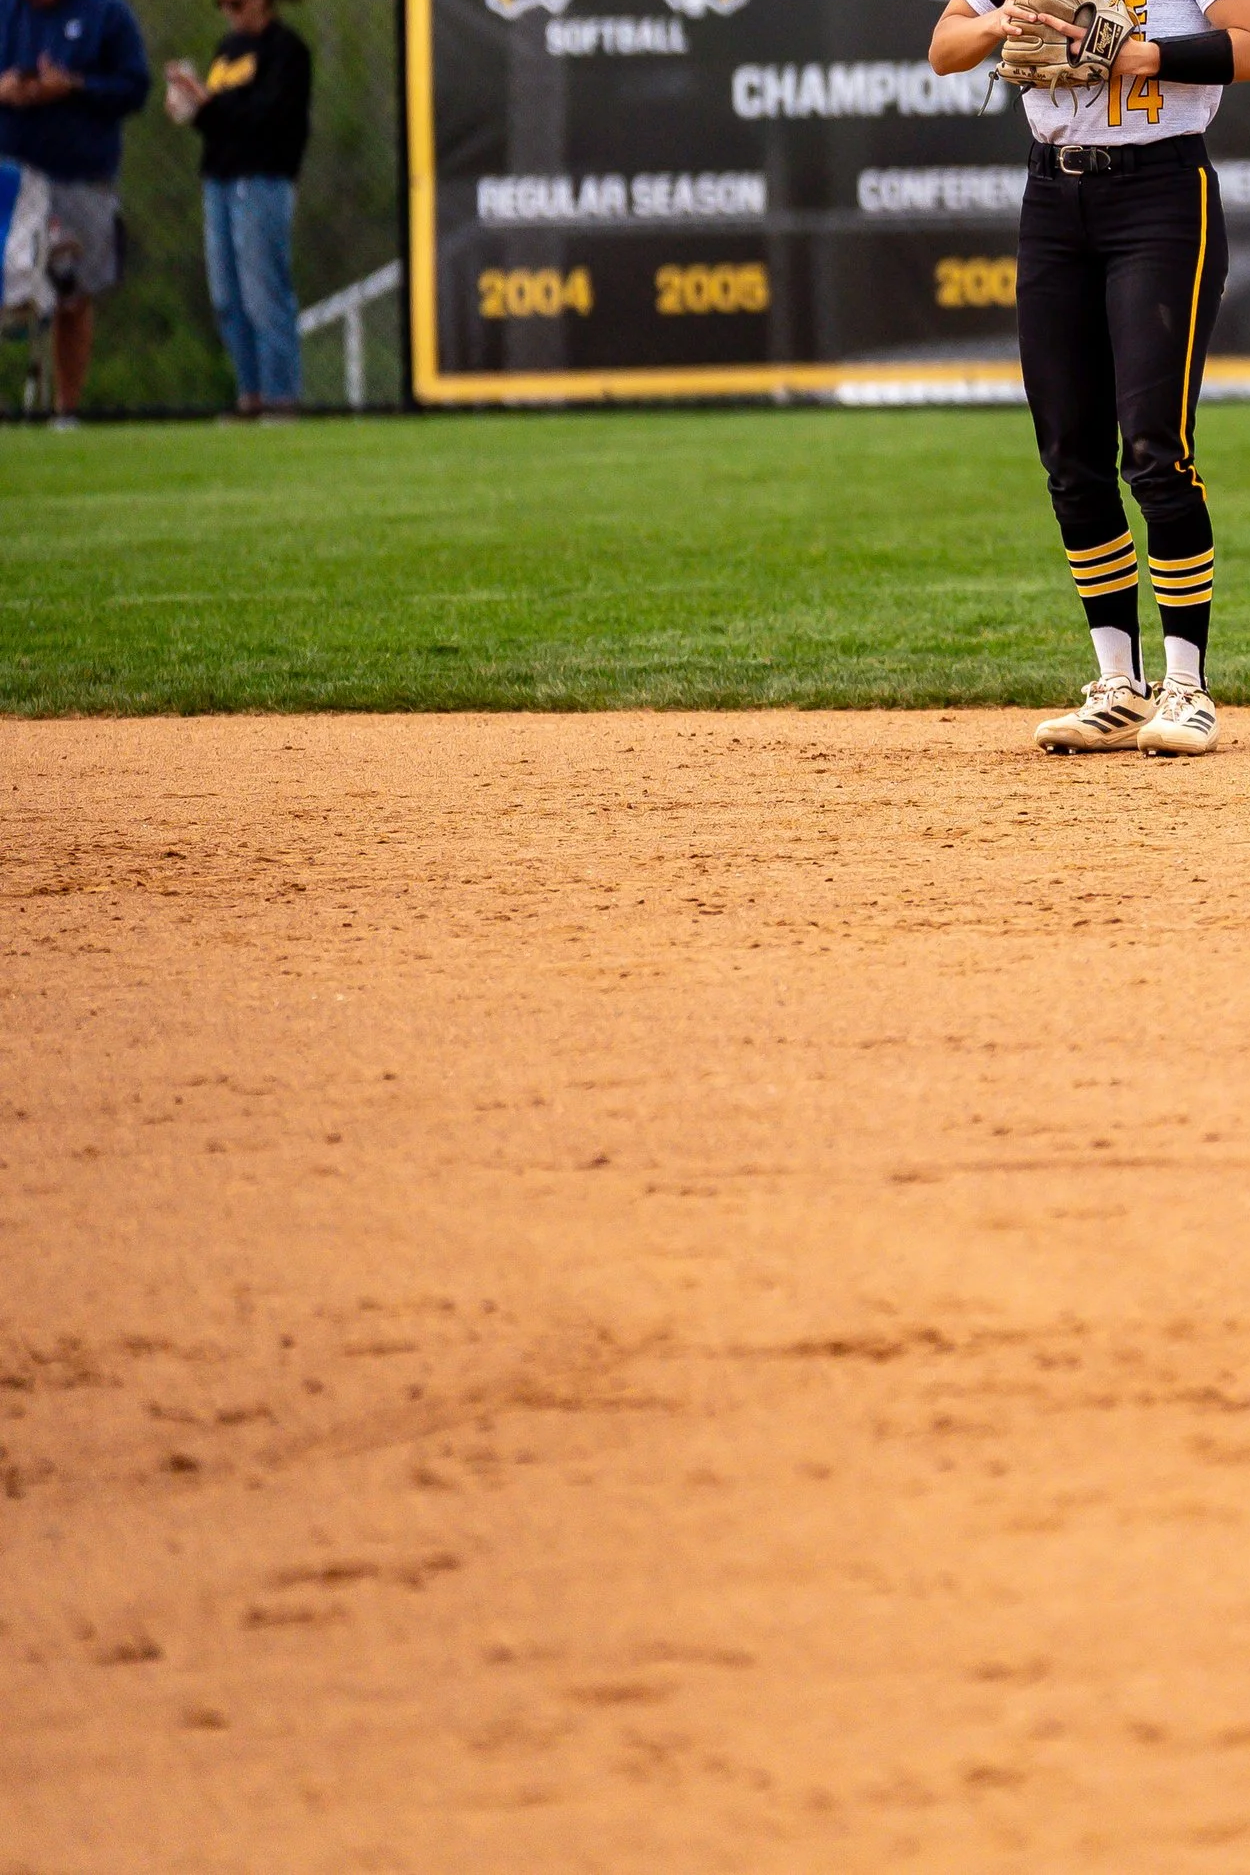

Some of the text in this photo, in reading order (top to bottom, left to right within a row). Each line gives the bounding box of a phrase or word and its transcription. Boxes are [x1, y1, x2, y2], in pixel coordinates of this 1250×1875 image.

[545, 18, 687, 56] SOFTBALL
[1108, 74, 1163, 127] 14
[478, 175, 766, 219] REGULAR SEASON
[478, 257, 1016, 317] 2004 2005 200
